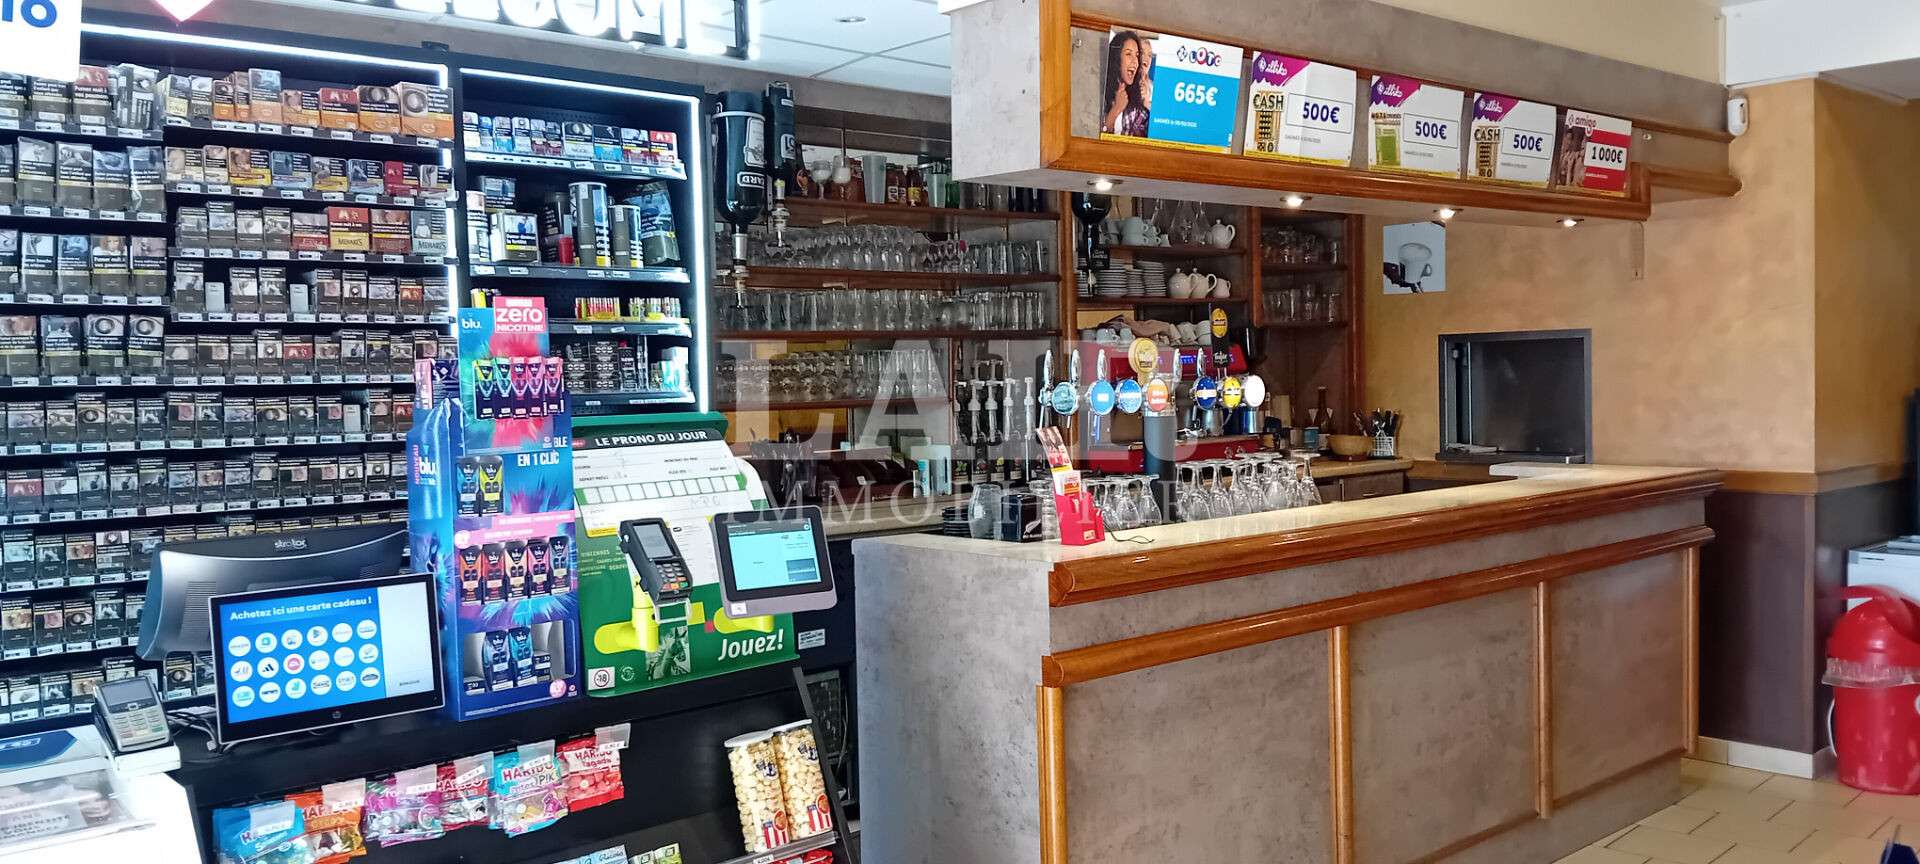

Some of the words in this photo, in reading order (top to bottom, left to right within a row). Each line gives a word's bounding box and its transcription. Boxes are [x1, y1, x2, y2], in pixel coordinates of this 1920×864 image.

[1174, 81, 1218, 107] 665€
[1252, 93, 1284, 111] CASH
[1302, 102, 1340, 124] 500€
[1415, 121, 1448, 140] 500€
[1474, 128, 1501, 142] CASH
[1512, 134, 1543, 152] 500€
[496, 307, 543, 323] zero
[496, 324, 544, 332] NICOTINE
[594, 437, 610, 447] LE
[612, 434, 654, 446] PRONO
[657, 432, 675, 443] DU
[678, 431, 708, 442] JOUR
[517, 454, 531, 467] EN
[540, 451, 560, 465] CLIC
[230, 609, 272, 621] Achetez
[272, 607, 285, 616] ici
[286, 605, 305, 614] une
[306, 602, 331, 611] carte
[333, 598, 367, 609] cadeau
[718, 629, 784, 661] Jouez!
[575, 748, 614, 760] HARO
